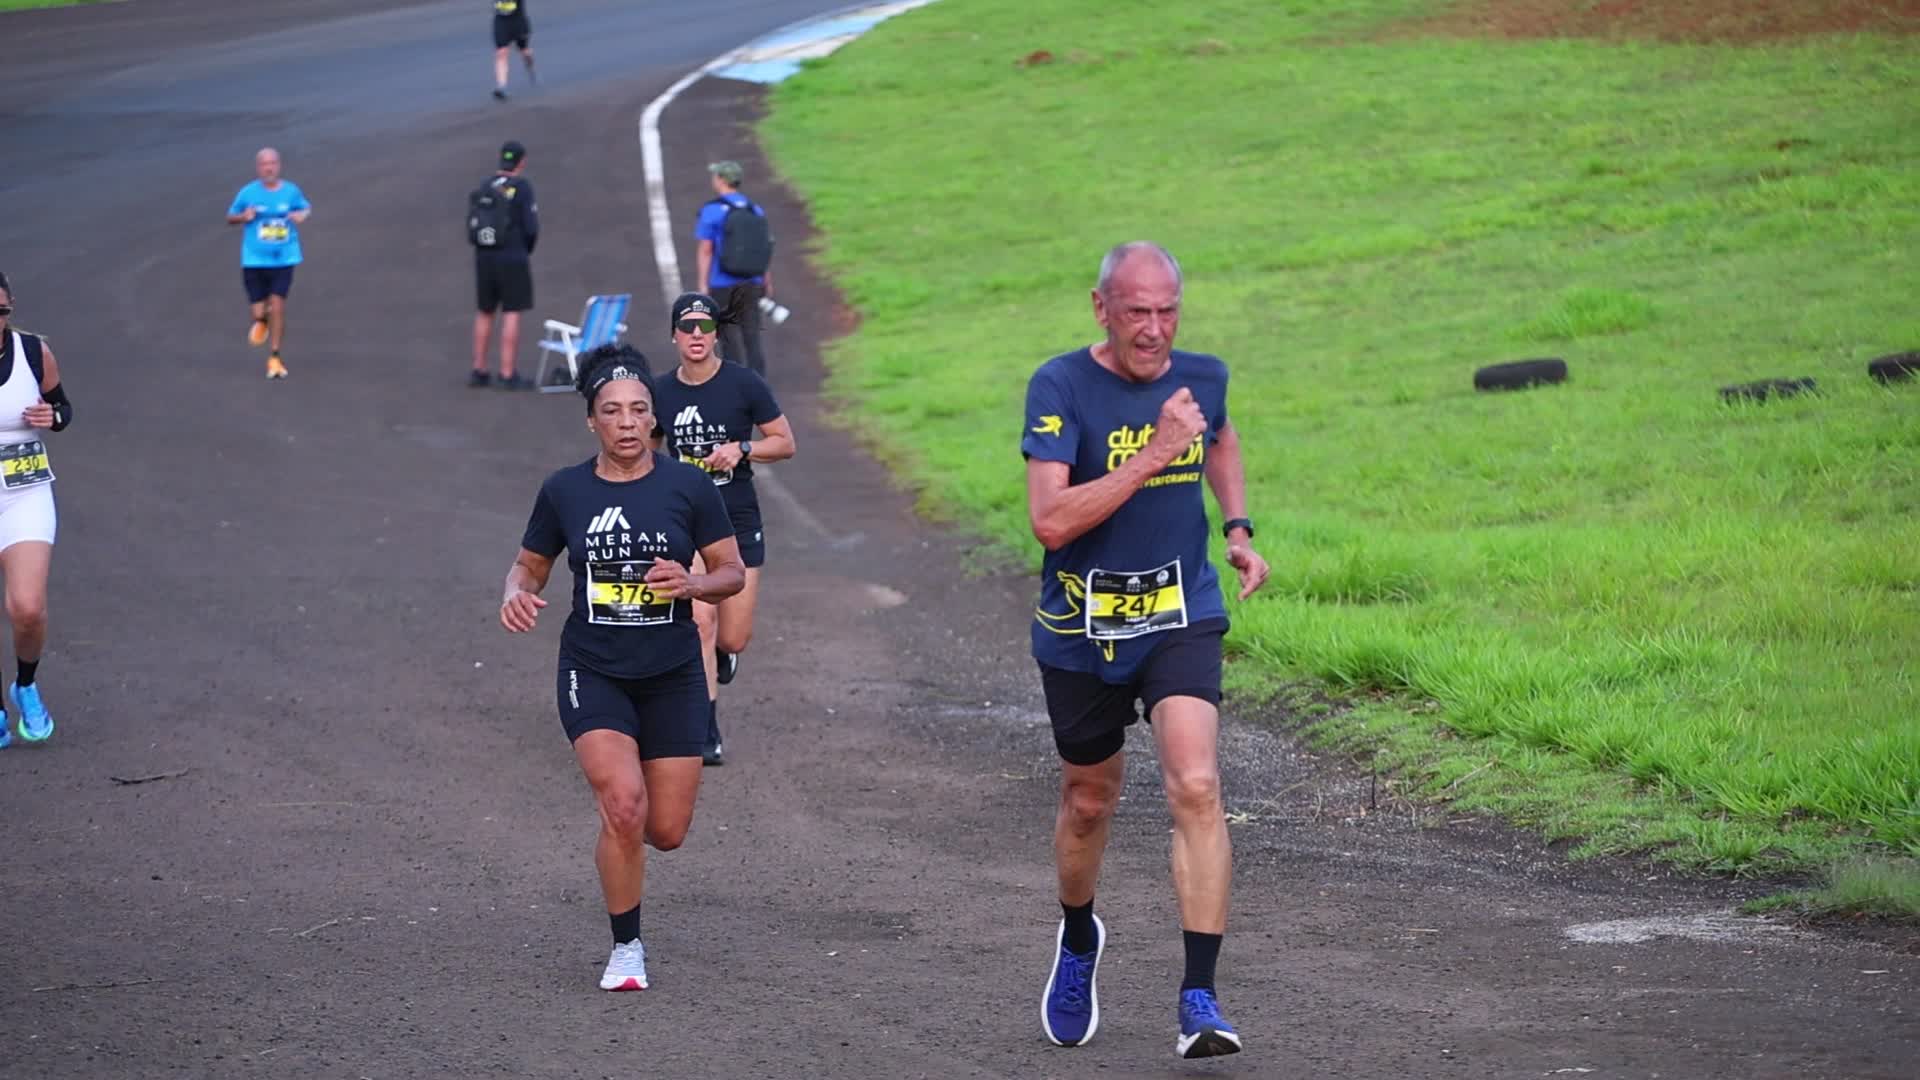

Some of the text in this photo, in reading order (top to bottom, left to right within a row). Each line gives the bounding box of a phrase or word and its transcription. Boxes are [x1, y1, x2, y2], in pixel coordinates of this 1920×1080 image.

[674, 424, 727, 436] MERAK
[13, 456, 40, 472] 230
[585, 532, 668, 548] MERAK
[588, 546, 631, 562] RUN
[611, 584, 655, 604] 376
[1113, 592, 1160, 616] 247
